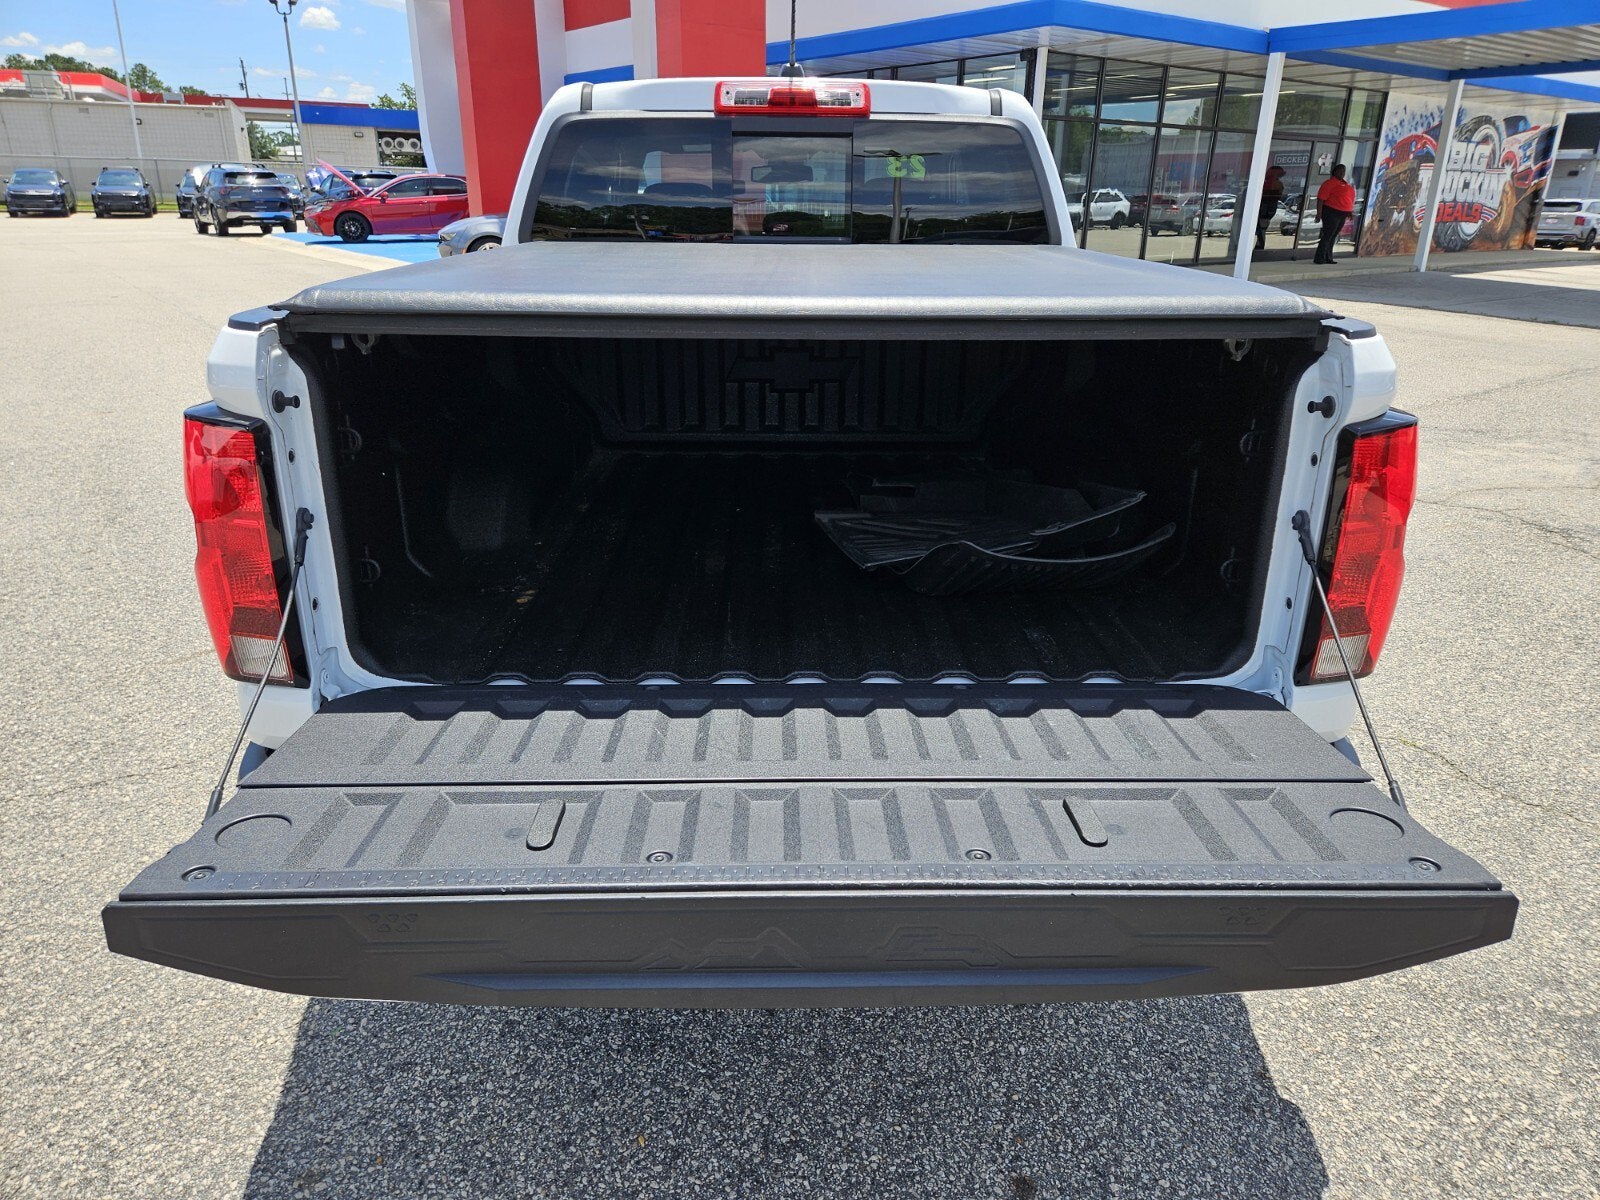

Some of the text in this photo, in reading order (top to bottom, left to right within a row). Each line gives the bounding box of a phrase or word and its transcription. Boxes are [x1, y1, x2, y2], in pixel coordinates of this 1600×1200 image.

[1276, 155, 1308, 165] DECKED
[1447, 141, 1491, 171] BIG
[1416, 168, 1505, 210] TUCKIN
[1435, 202, 1483, 223] DEALS
